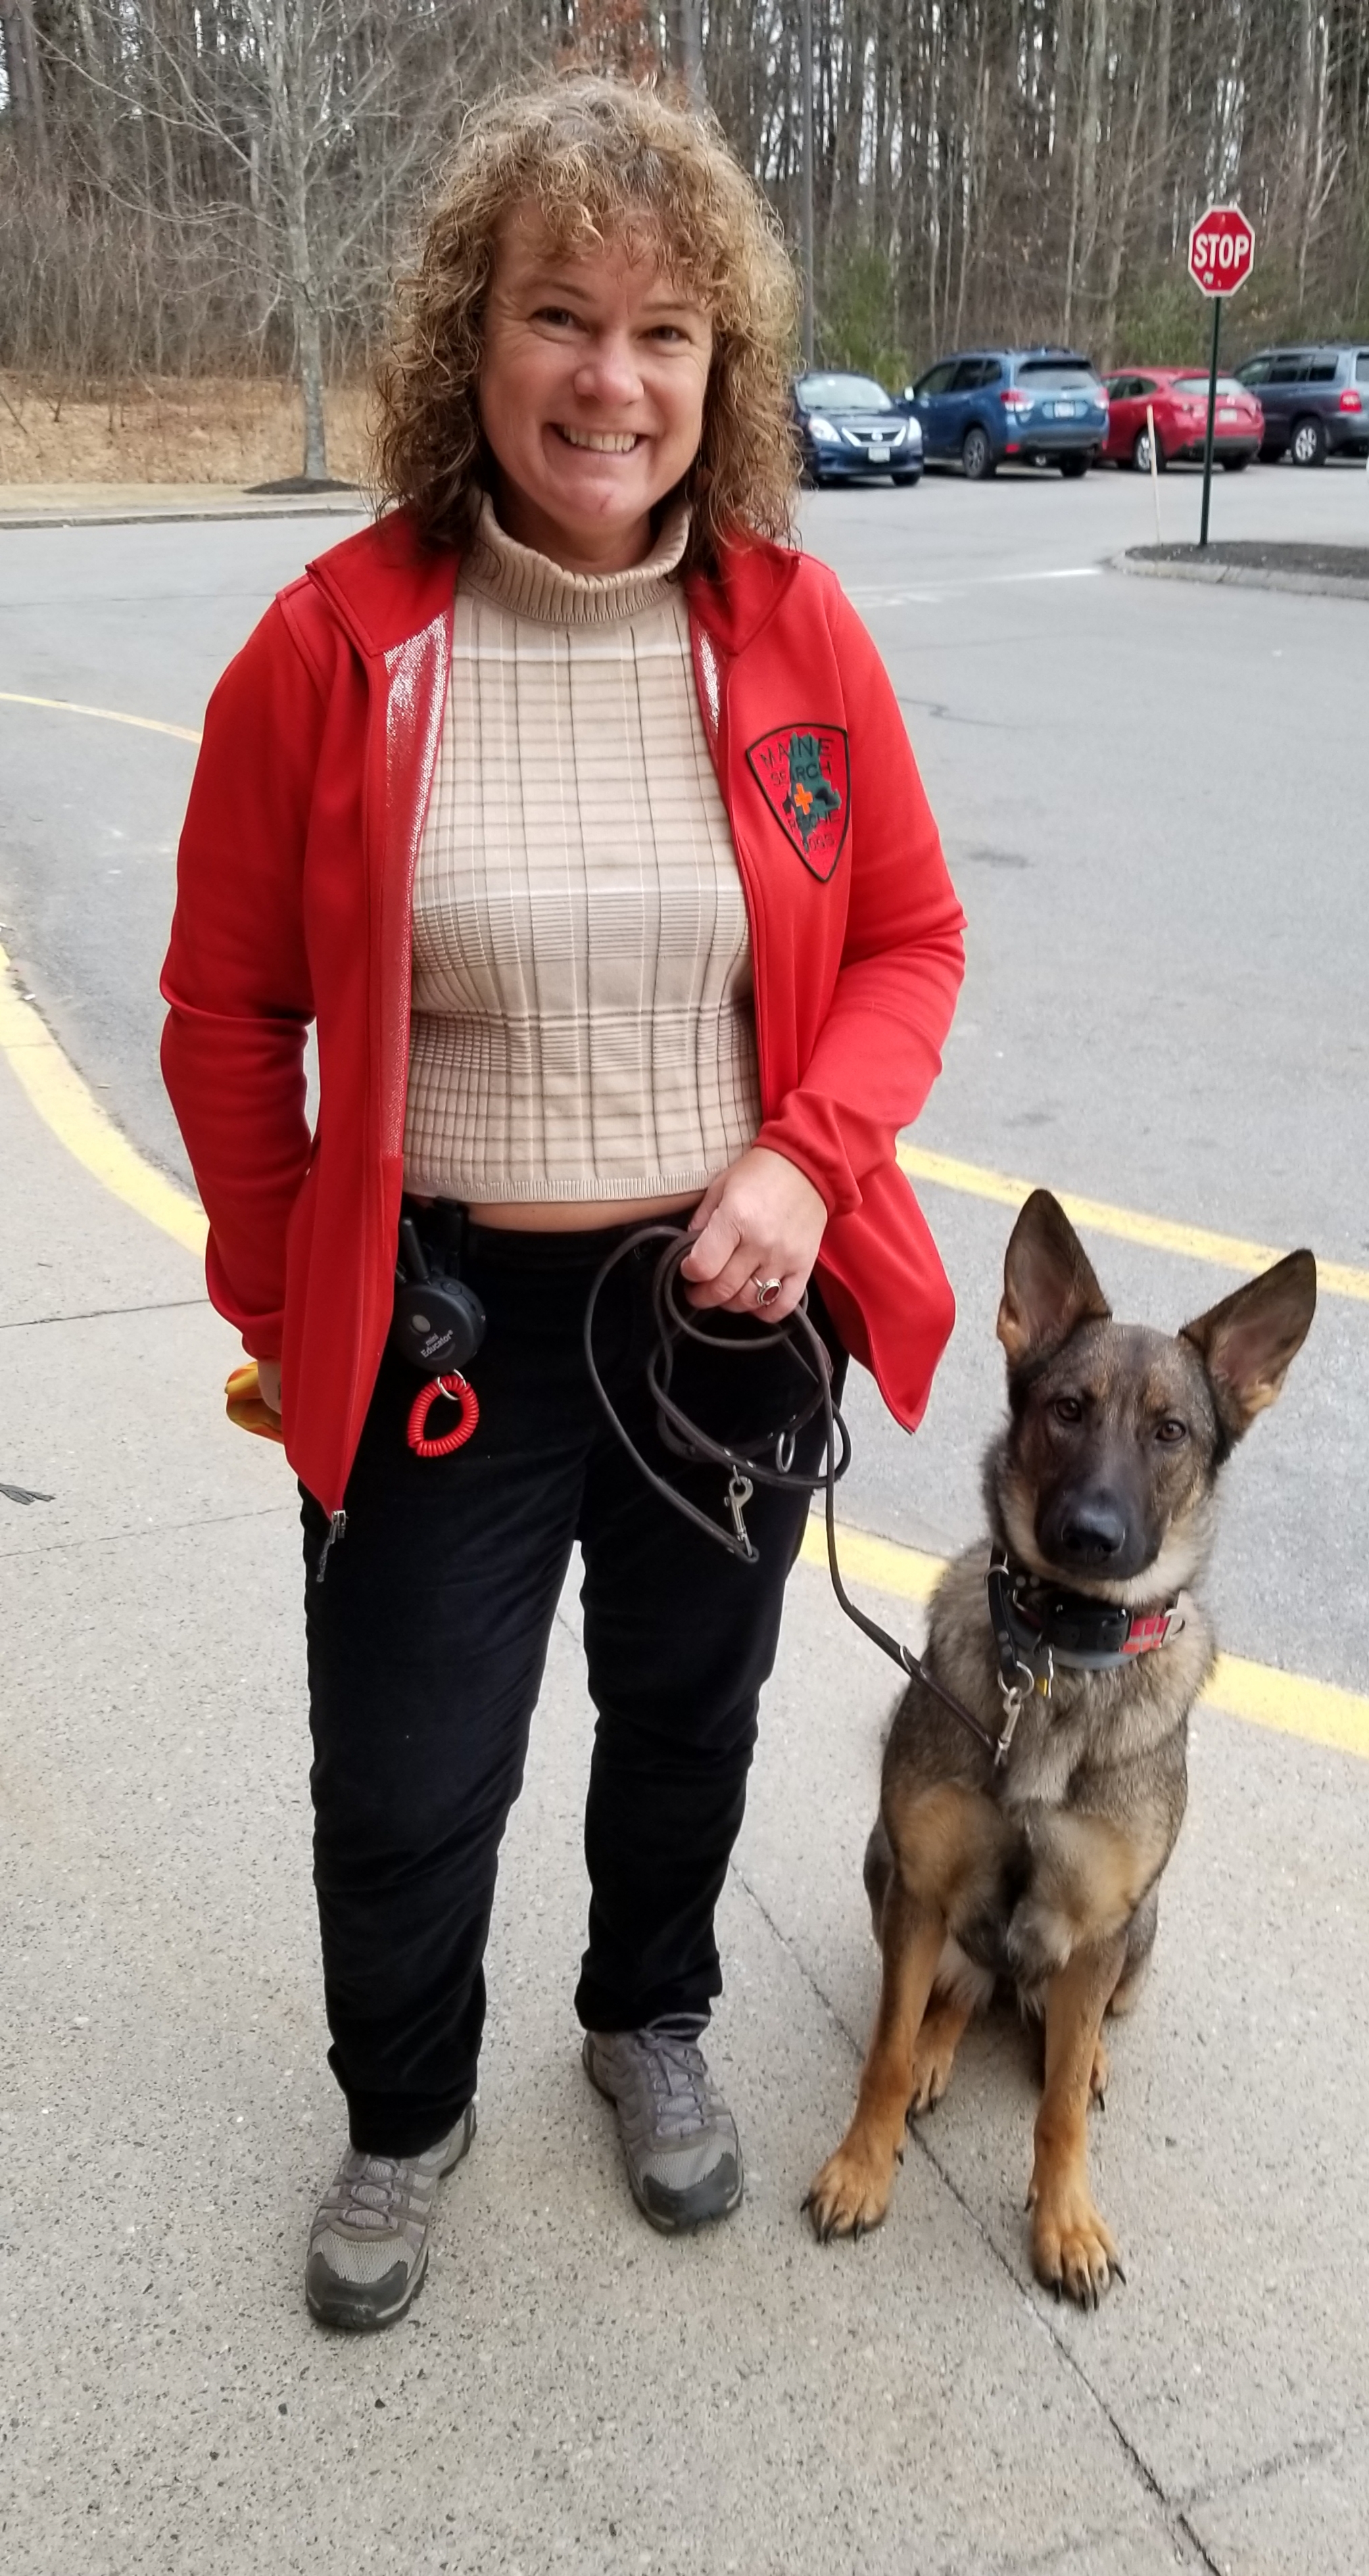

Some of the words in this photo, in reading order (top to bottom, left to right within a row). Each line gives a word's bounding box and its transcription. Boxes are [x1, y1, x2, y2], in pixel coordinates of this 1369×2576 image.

[1193, 233, 1249, 269] STOP
[759, 736, 834, 770] MAINE
[421, 1333, 452, 1358] Educator
